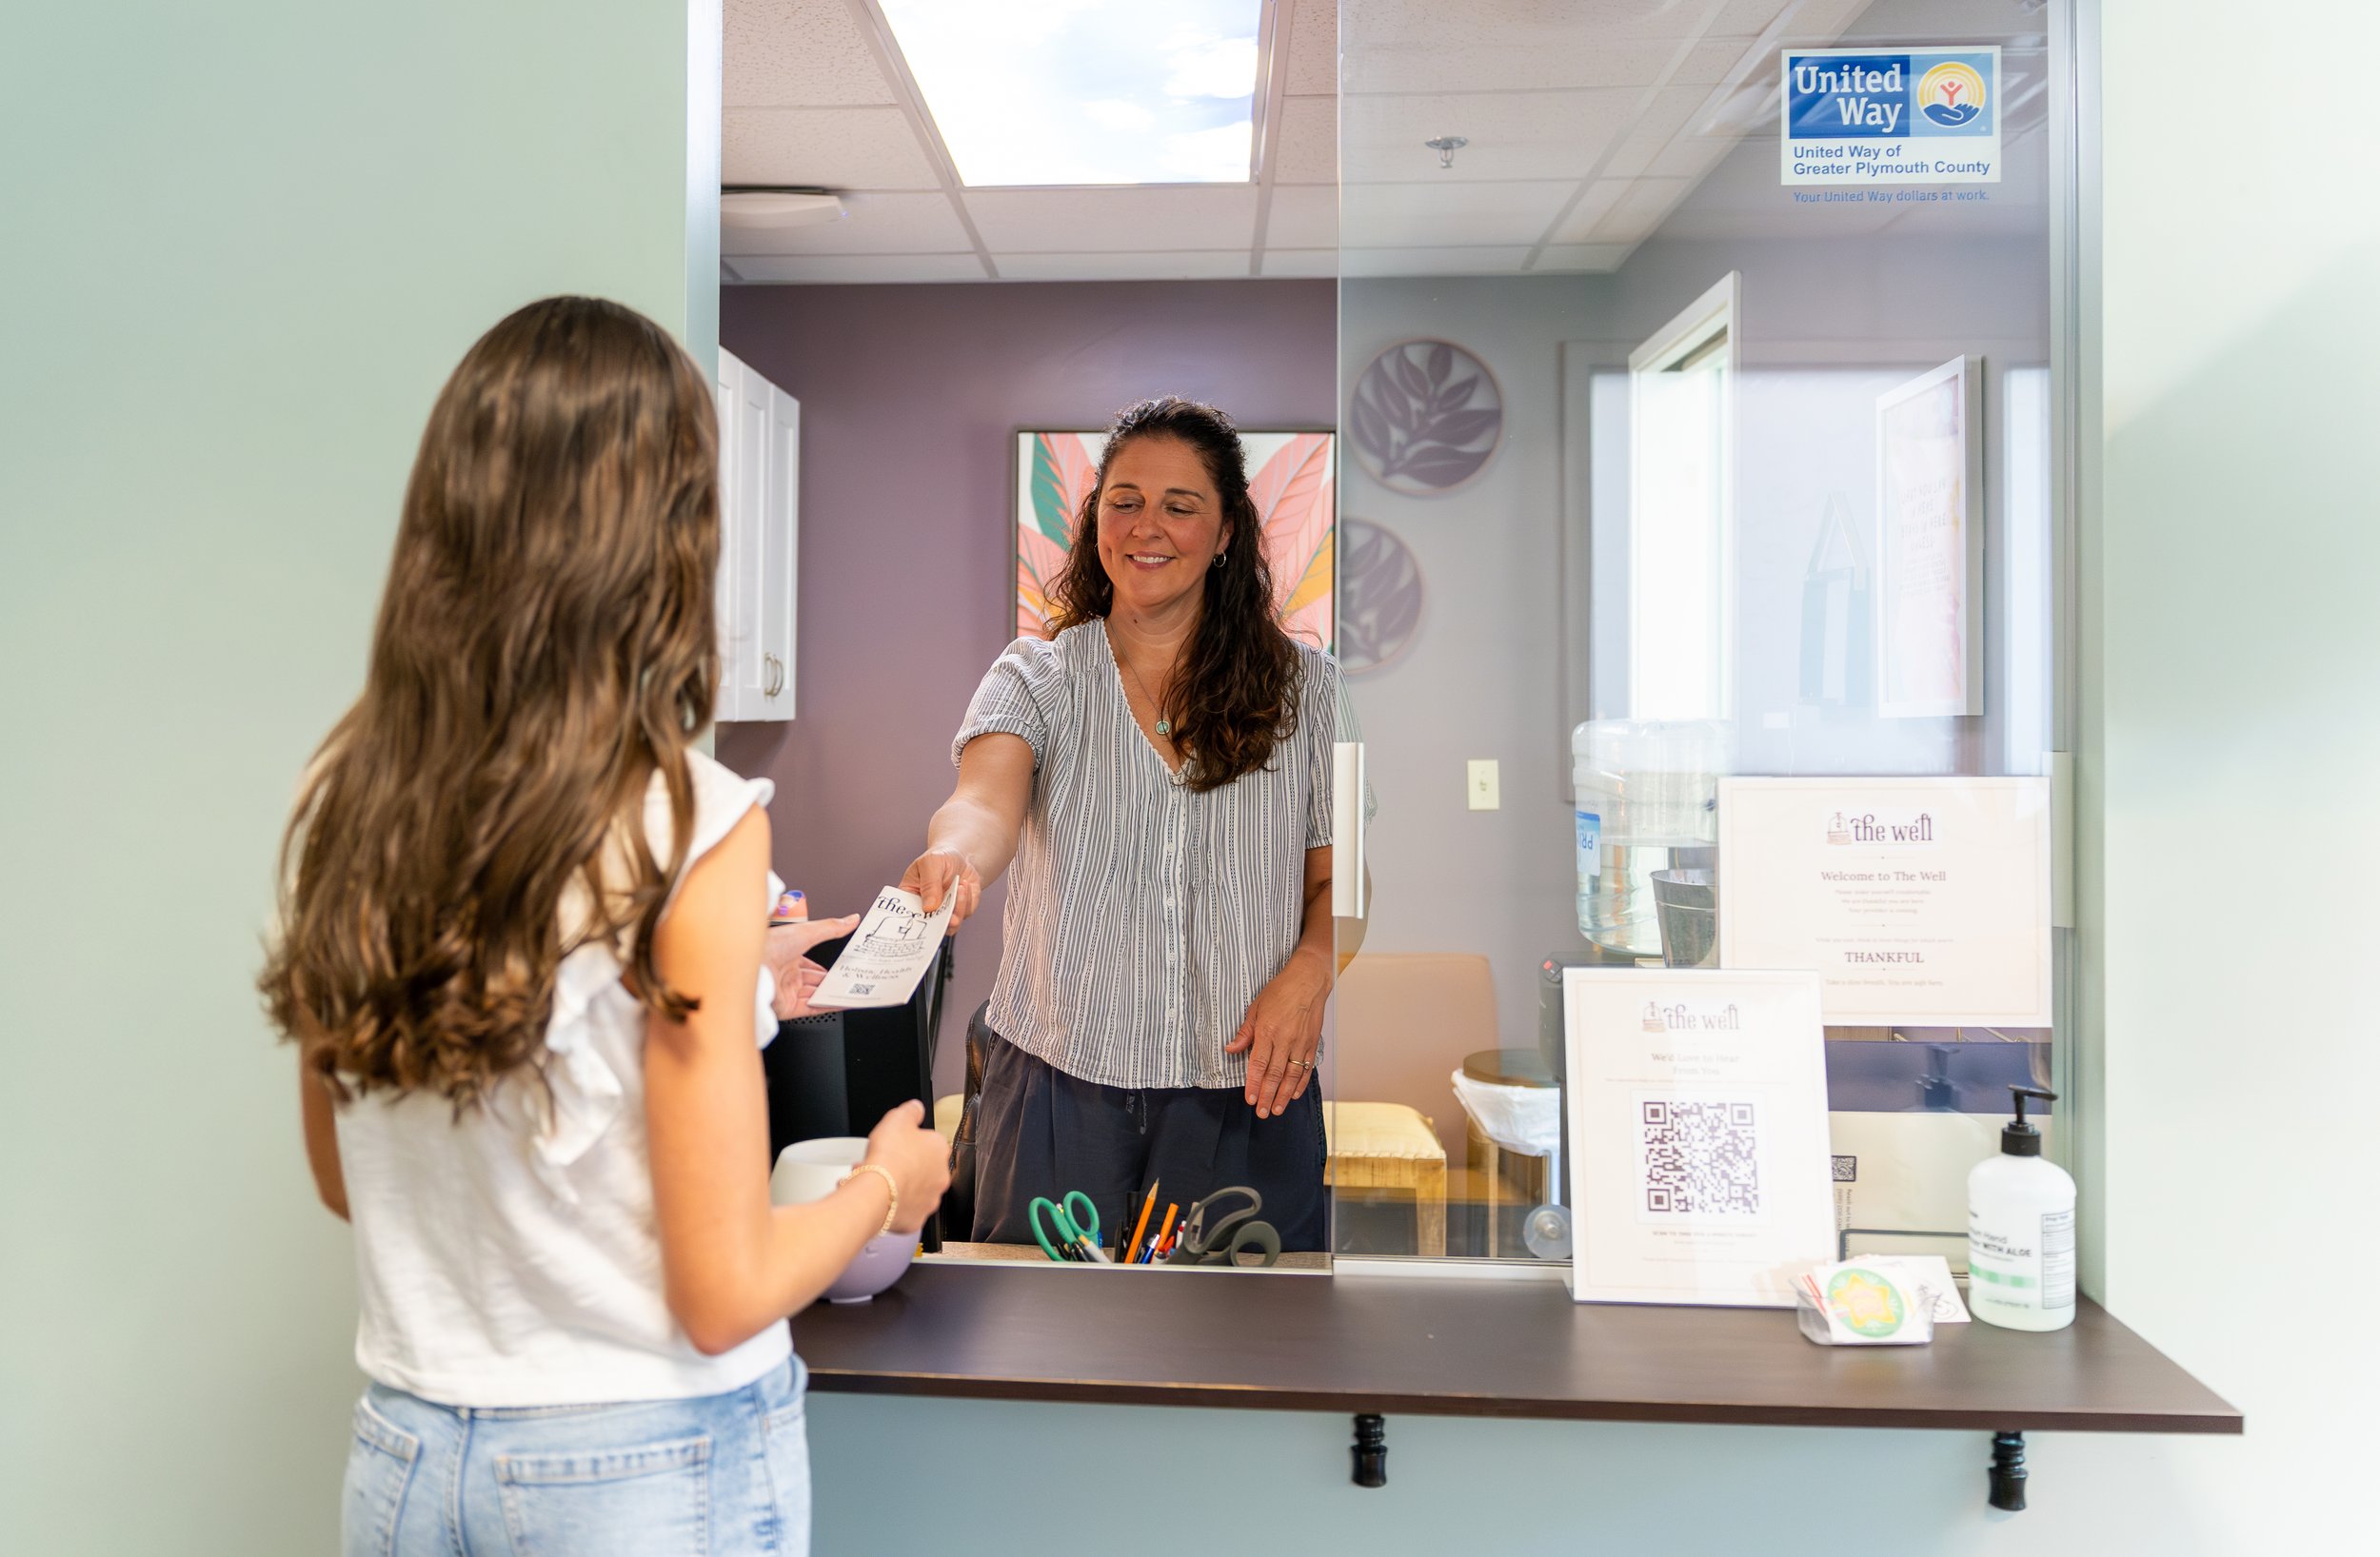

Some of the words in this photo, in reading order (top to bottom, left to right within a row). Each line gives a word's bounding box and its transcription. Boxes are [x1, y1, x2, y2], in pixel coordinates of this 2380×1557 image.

[1795, 63, 1903, 94] United
[1836, 97, 1903, 133] Way
[1794, 146, 1843, 159] United
[1848, 146, 1881, 161] Way
[1885, 144, 1902, 158] of
[1794, 162, 1852, 175] Greater
[1855, 161, 1930, 177] Plymouth
[1934, 160, 1992, 176] County
[1794, 191, 1821, 203] Your
[1824, 190, 1864, 203] United
[1867, 190, 1894, 204] Way
[1895, 189, 1938, 202] dollars
[1941, 190, 1953, 202] at
[1955, 188, 1990, 201] work.
[1851, 814, 1885, 842] the
[1892, 813, 1934, 842] well
[1820, 871, 1874, 882] Welcome
[1877, 872, 1891, 882] to
[1894, 871, 1915, 882] The
[1919, 871, 1947, 882] Well
[878, 897, 906, 915] the
[1845, 952, 1925, 964] THANKFUL
[1663, 1004, 1696, 1030] the
[1701, 1004, 1740, 1031] well
[2006, 1247, 2033, 1258] ALOE
